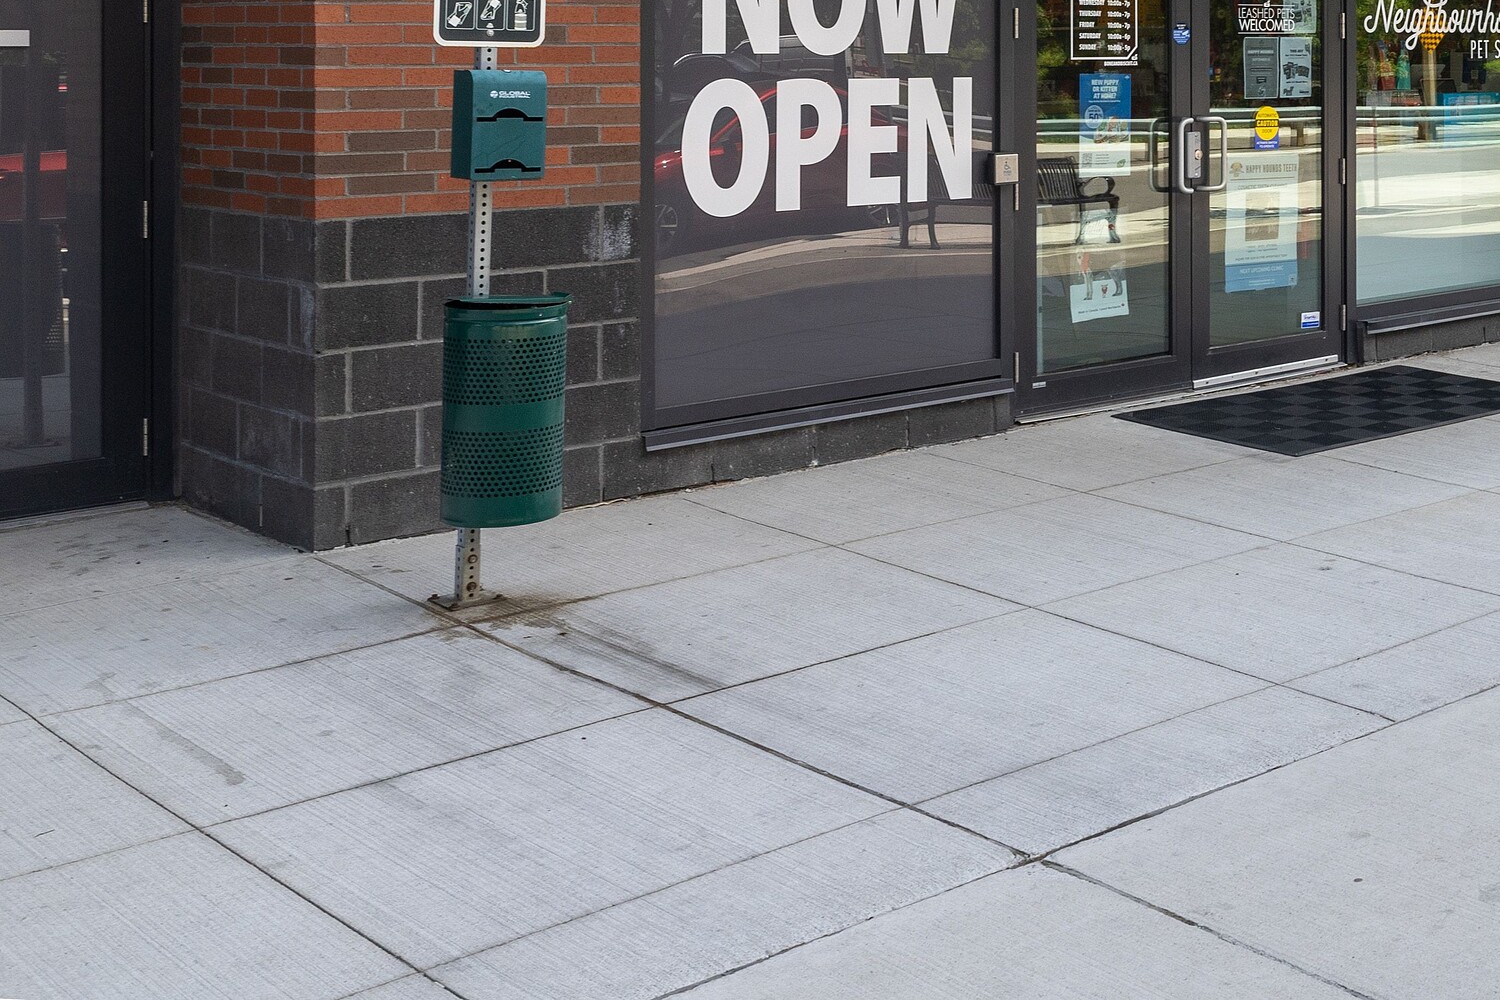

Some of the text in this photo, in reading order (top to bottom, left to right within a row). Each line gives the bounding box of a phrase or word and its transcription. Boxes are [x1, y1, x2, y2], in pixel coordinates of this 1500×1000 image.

[1238, 8, 1295, 19] LEASHED PETS
[1238, 19, 1295, 32] WELCOMED
[1470, 39, 1489, 59] PET
[681, 77, 972, 217] OPEN
[1246, 163, 1297, 173] HAPPY HOUNDS TEETH
